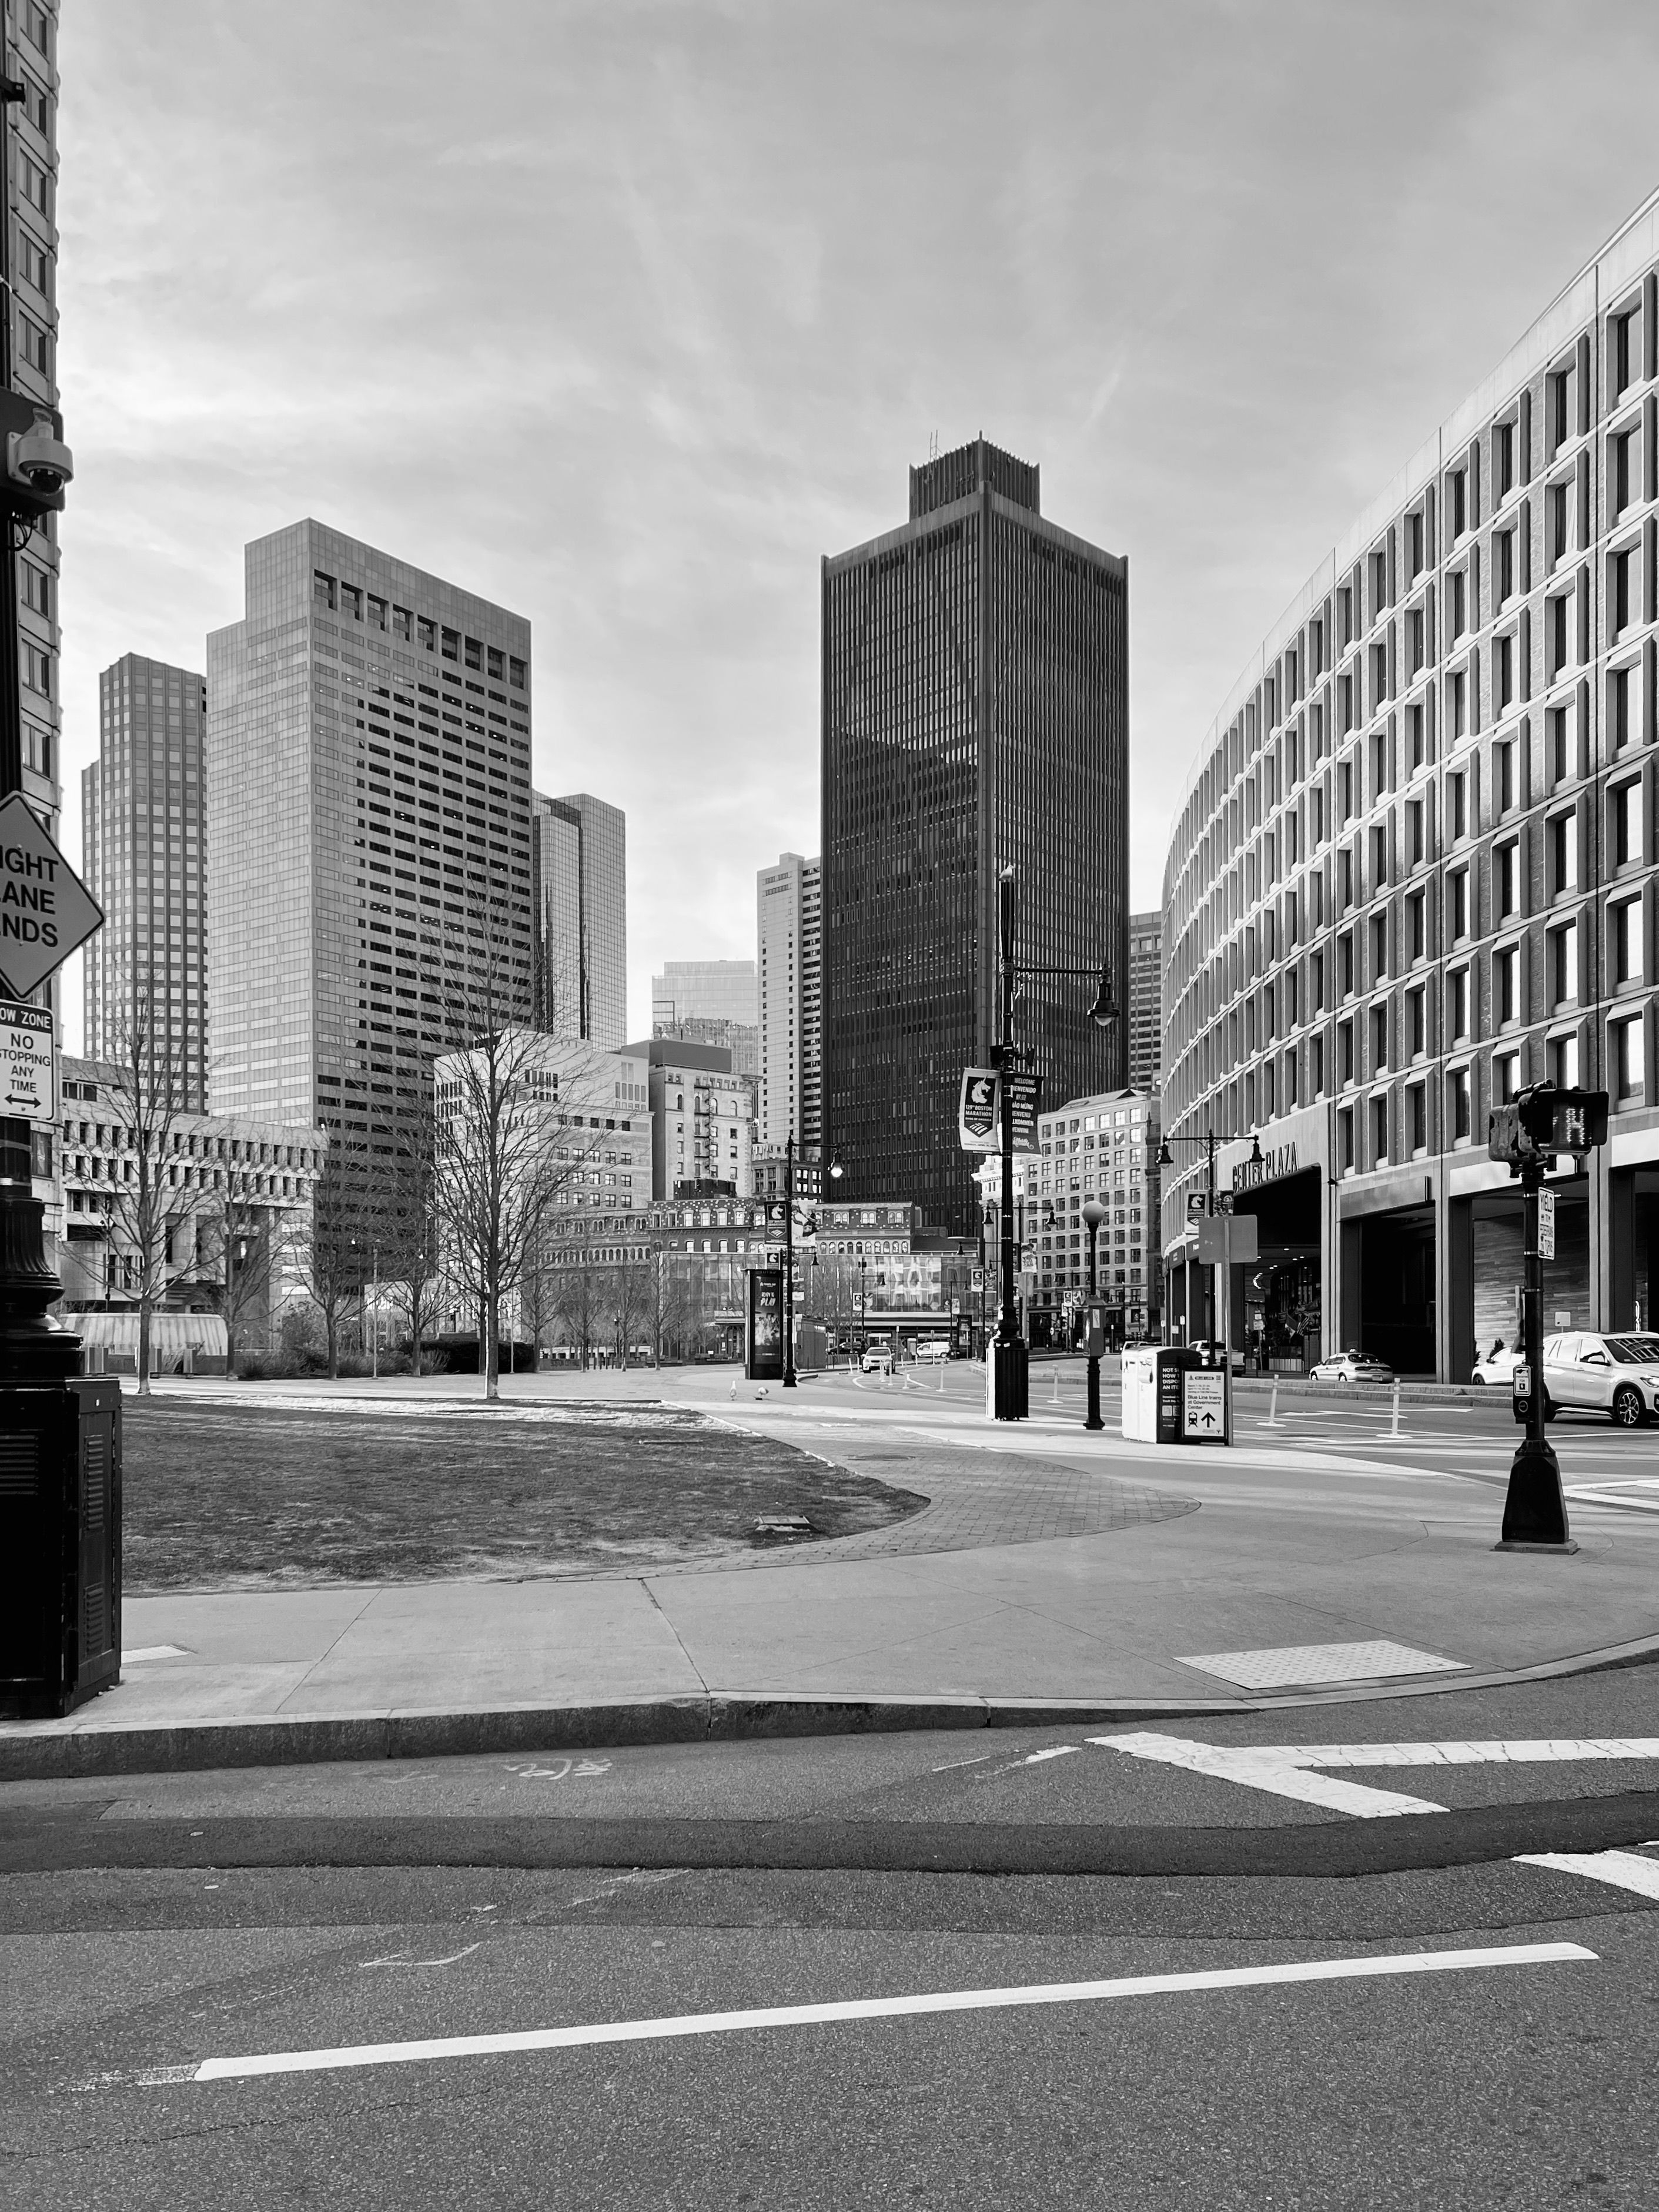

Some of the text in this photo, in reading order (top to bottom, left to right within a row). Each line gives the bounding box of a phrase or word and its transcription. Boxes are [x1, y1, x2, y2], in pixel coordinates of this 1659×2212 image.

[0, 845, 59, 882] IGHT
[0, 881, 56, 915] ANE
[0, 913, 58, 948] NDS
[0, 1007, 51, 1029] OW ZONE
[11, 1033, 34, 1049] NO
[11, 1065, 35, 1078] ANY
[1014, 1077, 1036, 1086] WELCOME
[9, 1079, 37, 1093] TIME
[1233, 1141, 1299, 1194] CENTER PLAZA
[1540, 1193, 1553, 1213] YIELD
[760, 1297, 776, 1306] PLAY
